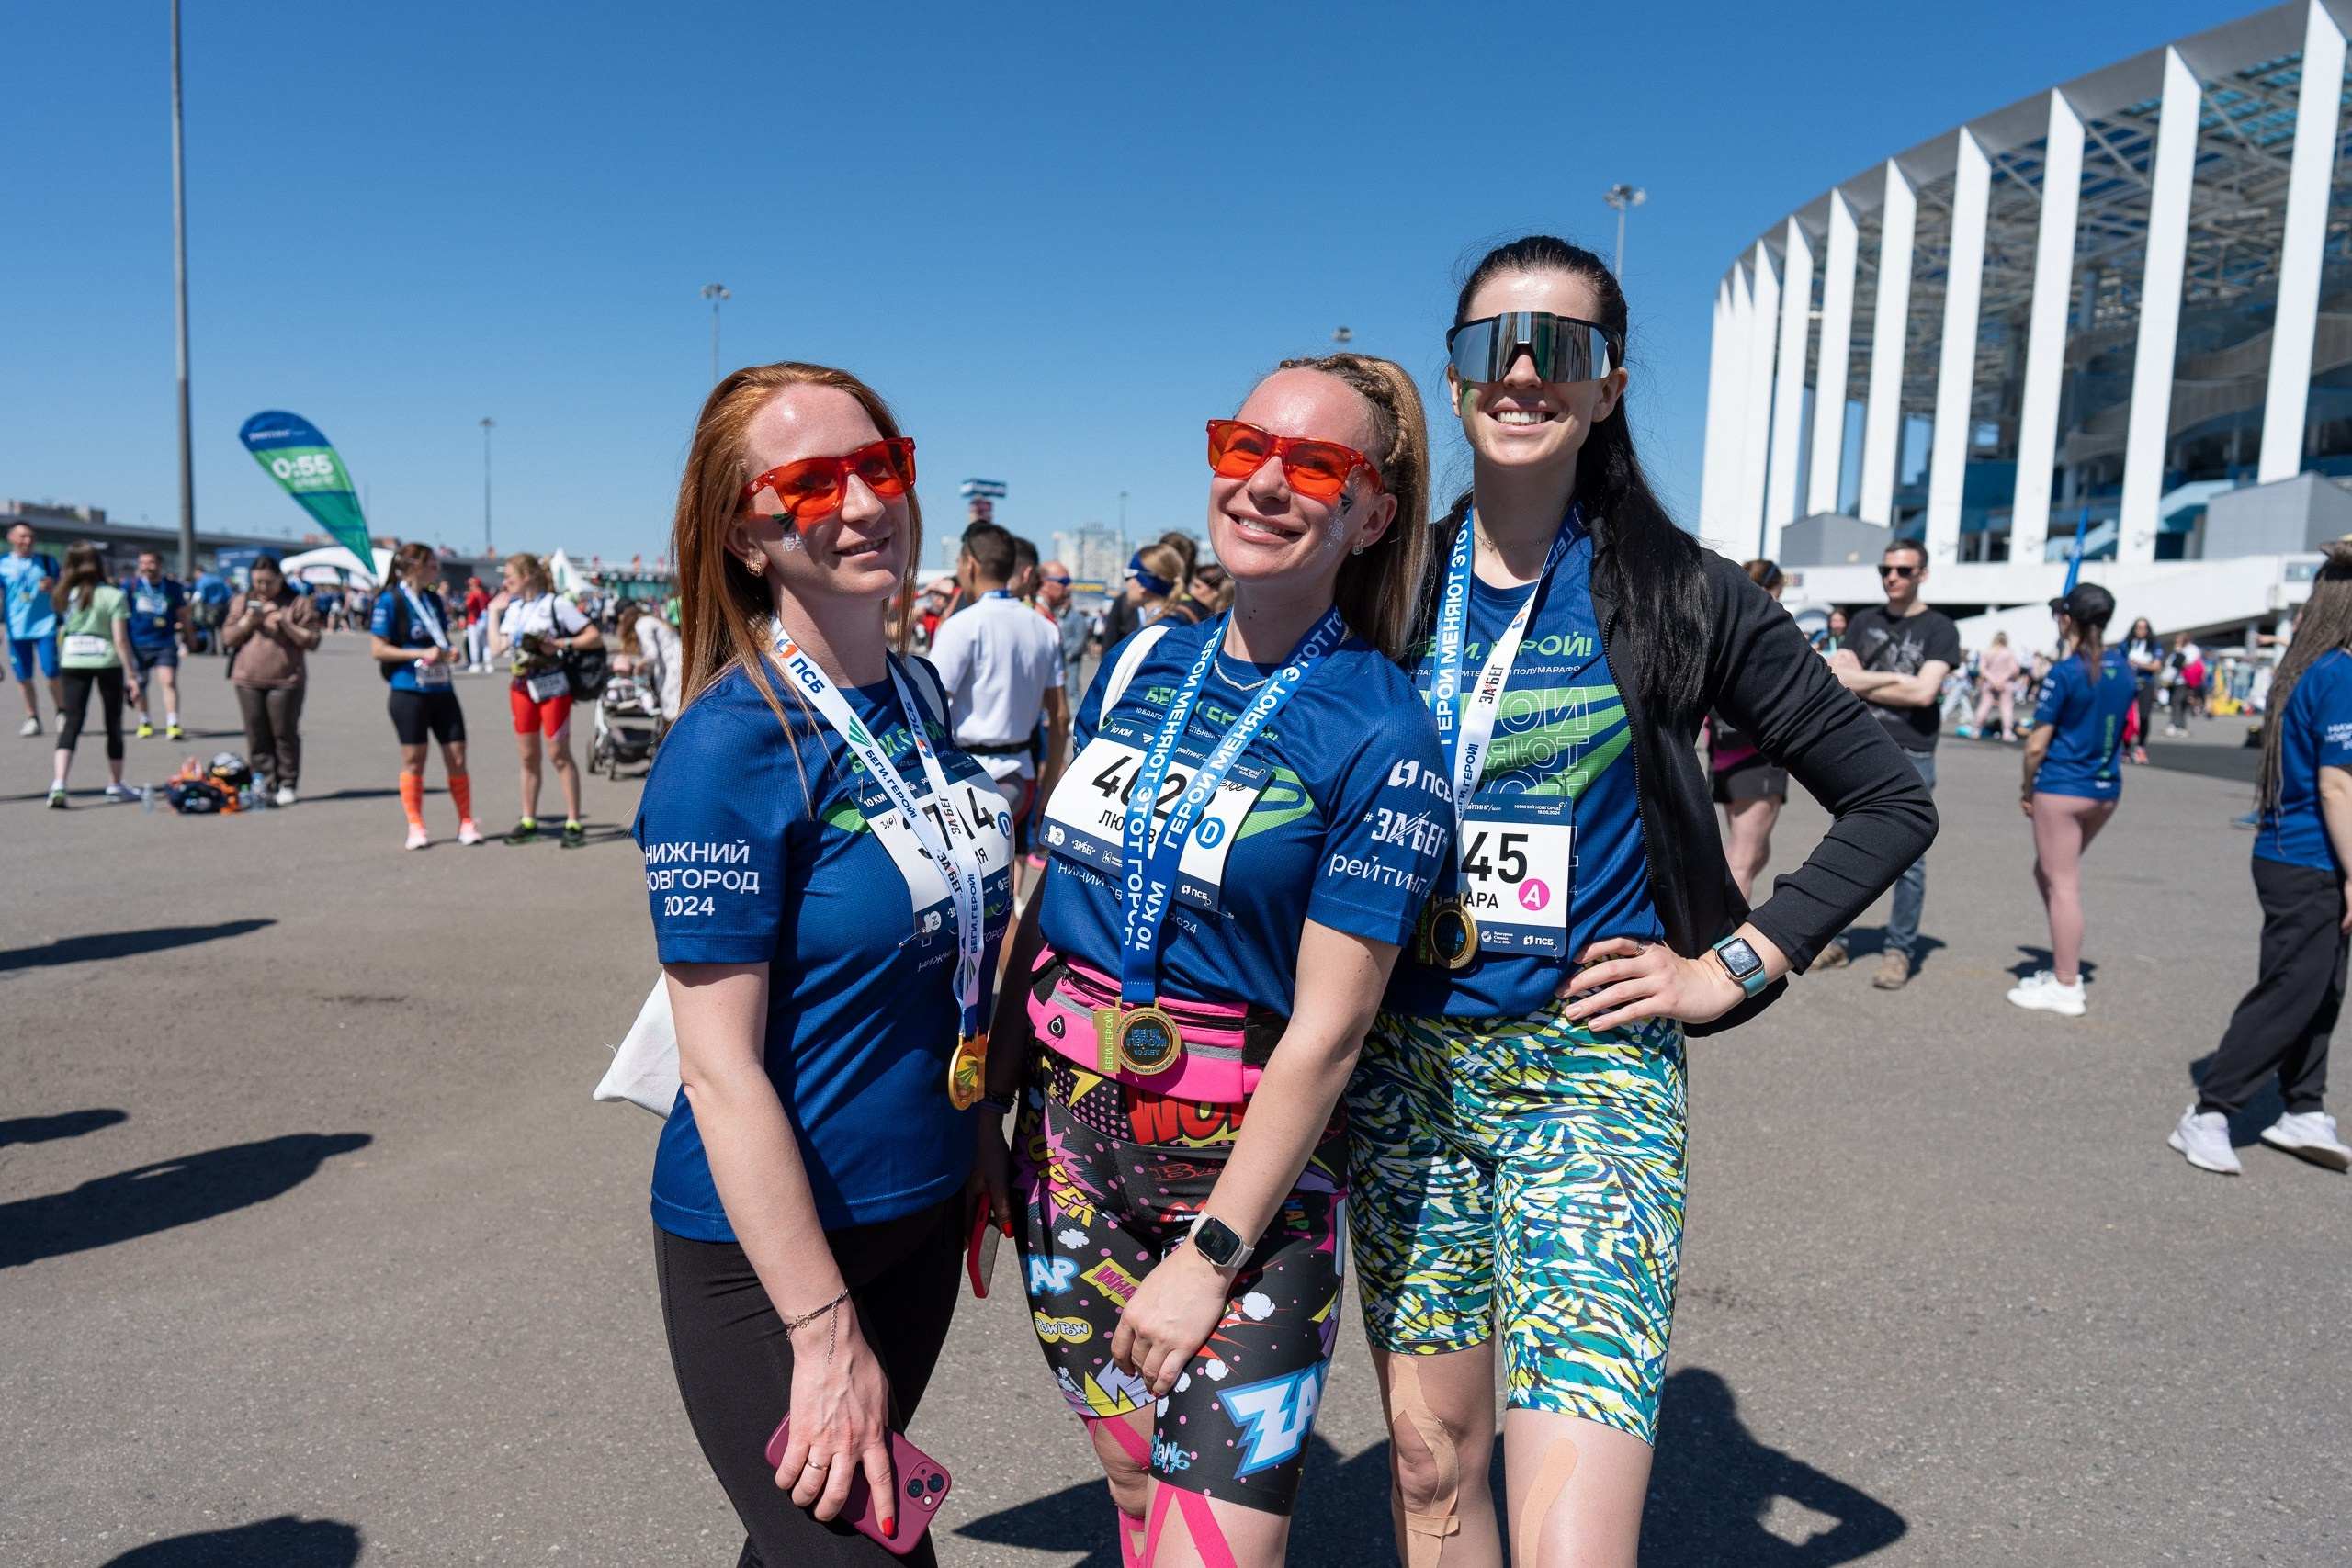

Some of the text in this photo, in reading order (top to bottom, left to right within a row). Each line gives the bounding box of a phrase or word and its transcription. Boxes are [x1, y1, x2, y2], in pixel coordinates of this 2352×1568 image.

[272, 454, 334, 479] 0:55
[1441, 572, 1464, 664] МЕНЯЮТ
[1184, 626, 1223, 688] ГЕРОИ
[1516, 665, 1581, 675] ПОЛУМАРАФО
[789, 658, 826, 694] ПСБ
[905, 701, 923, 737] ПСБ
[1145, 691, 1194, 784] МЕНЯЮТ
[1163, 772, 1217, 850] ГЕРОИ
[1209, 681, 1286, 771] МЕНЯЮТ
[1282, 630, 1329, 682] ЭТОТ
[886, 778, 918, 819] ГЕРОЙ!
[1129, 787, 1153, 853] ЭТОТ
[1199, 819, 1220, 844] D
[645, 839, 750, 864] НИЖНИЙ
[664, 895, 716, 917] 2024
[967, 874, 978, 919] ГЕРОЙ!
[1191, 888, 1208, 900] ПСБ
[1135, 926, 1152, 951] 10
[1535, 937, 1554, 946] ПСБ
